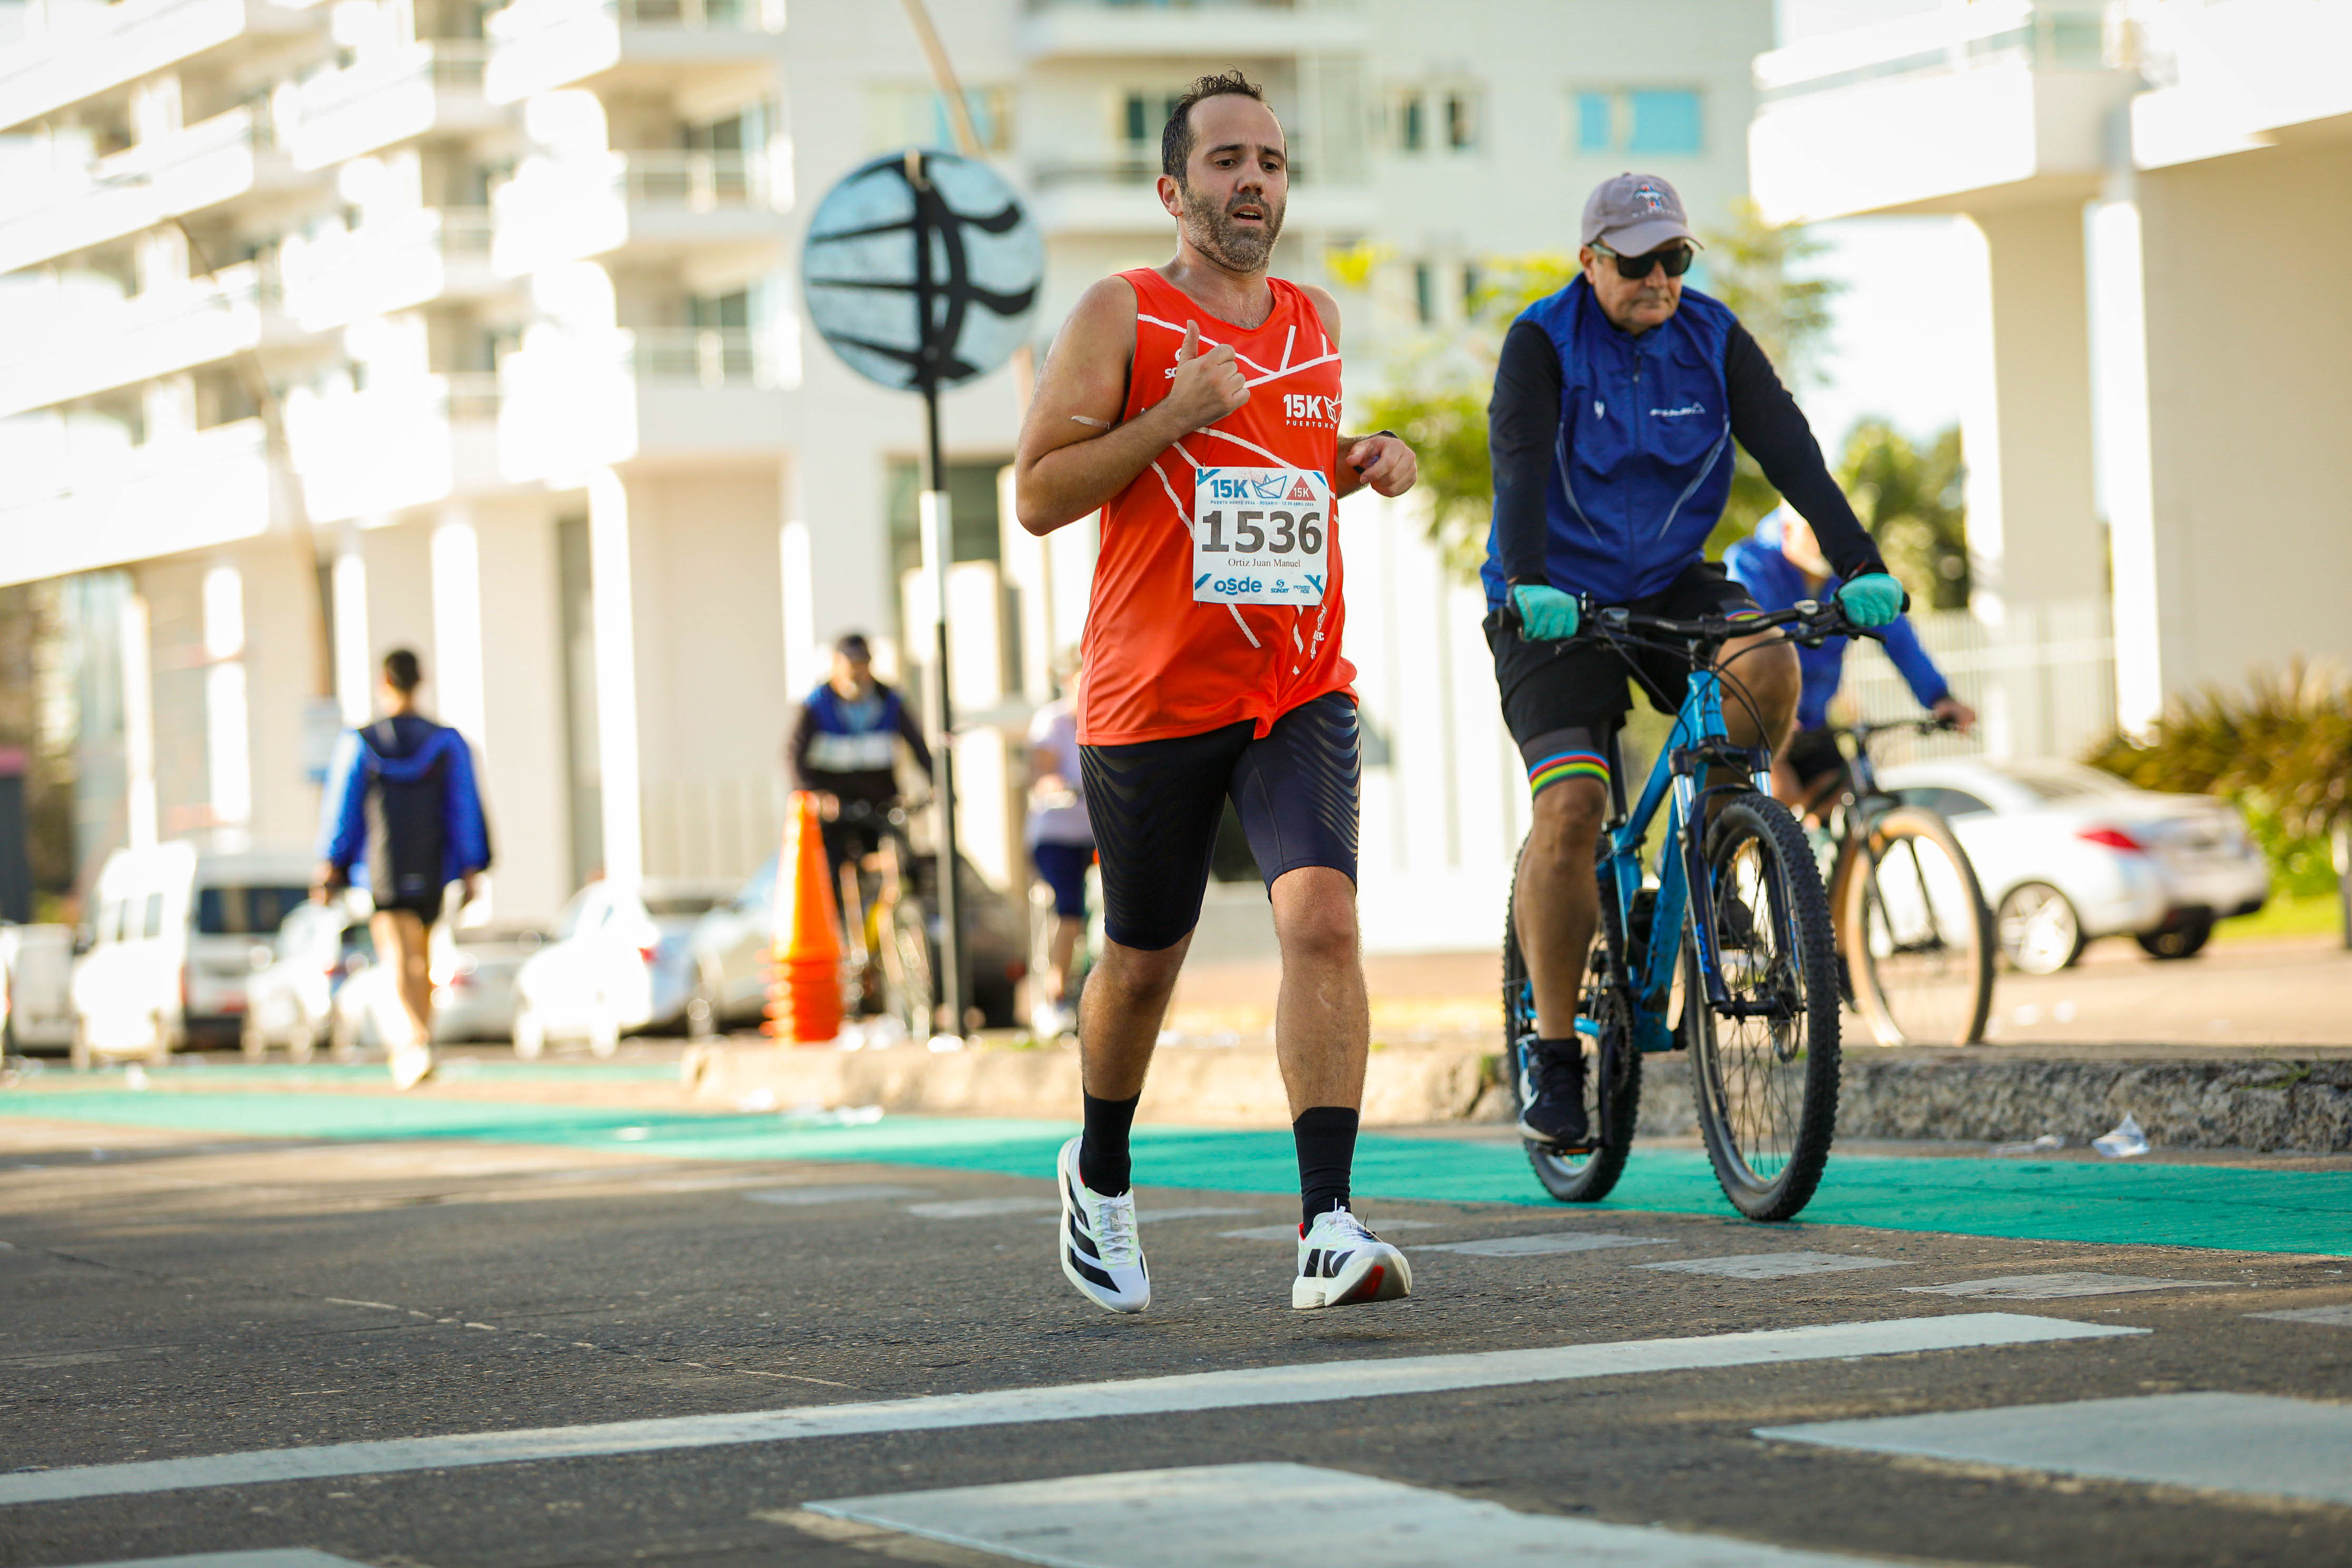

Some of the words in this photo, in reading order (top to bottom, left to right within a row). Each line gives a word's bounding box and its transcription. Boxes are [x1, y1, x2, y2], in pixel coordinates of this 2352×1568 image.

[1283, 394, 1322, 419] 15K
[1210, 479, 1249, 498] 15K
[1293, 487, 1309, 498] 15K
[1202, 510, 1322, 554] 1536
[1228, 557, 1250, 567] Ortiz
[1252, 558, 1271, 567] Juan
[1273, 558, 1301, 567] Manuel
[1214, 576, 1262, 594] osde
